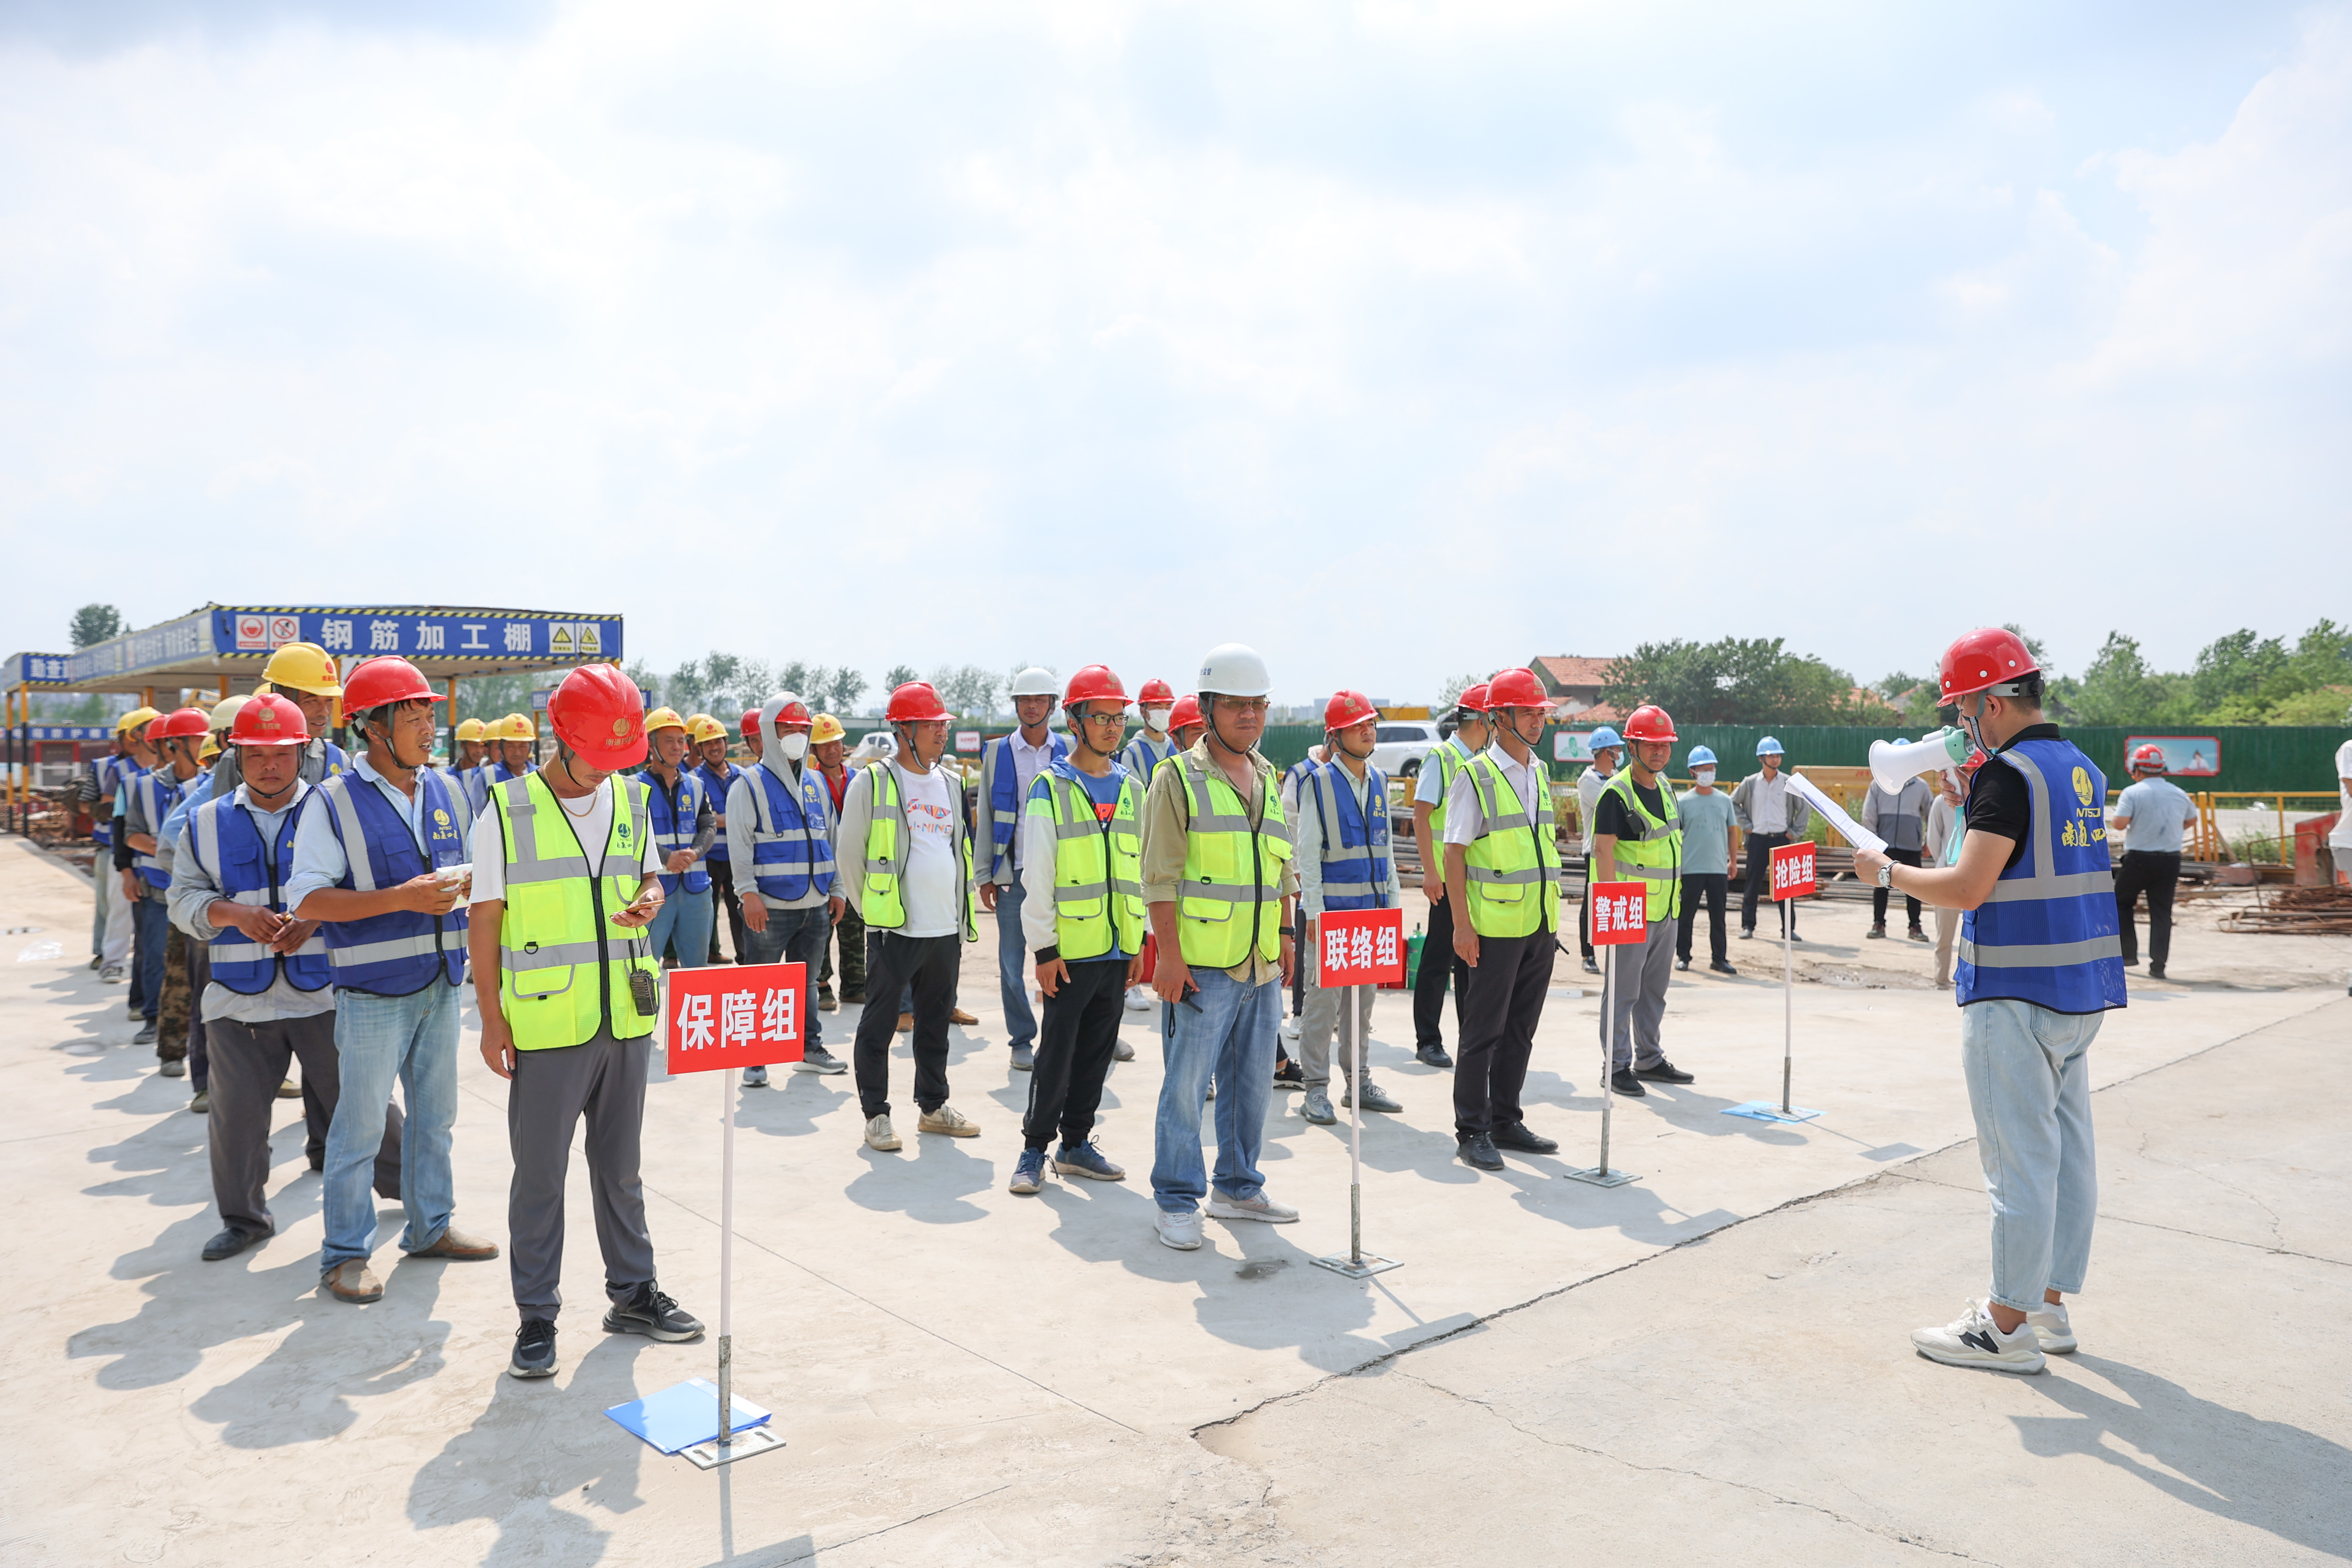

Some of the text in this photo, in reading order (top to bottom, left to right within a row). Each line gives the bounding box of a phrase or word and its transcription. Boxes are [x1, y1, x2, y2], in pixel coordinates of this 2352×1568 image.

[322, 618, 532, 652] 钢筋加工棚
[1775, 854, 1814, 889] 抢险组
[1595, 895, 1644, 932] 警戒组
[1325, 926, 1398, 971] 联络组
[677, 988, 797, 1051] 保障组
